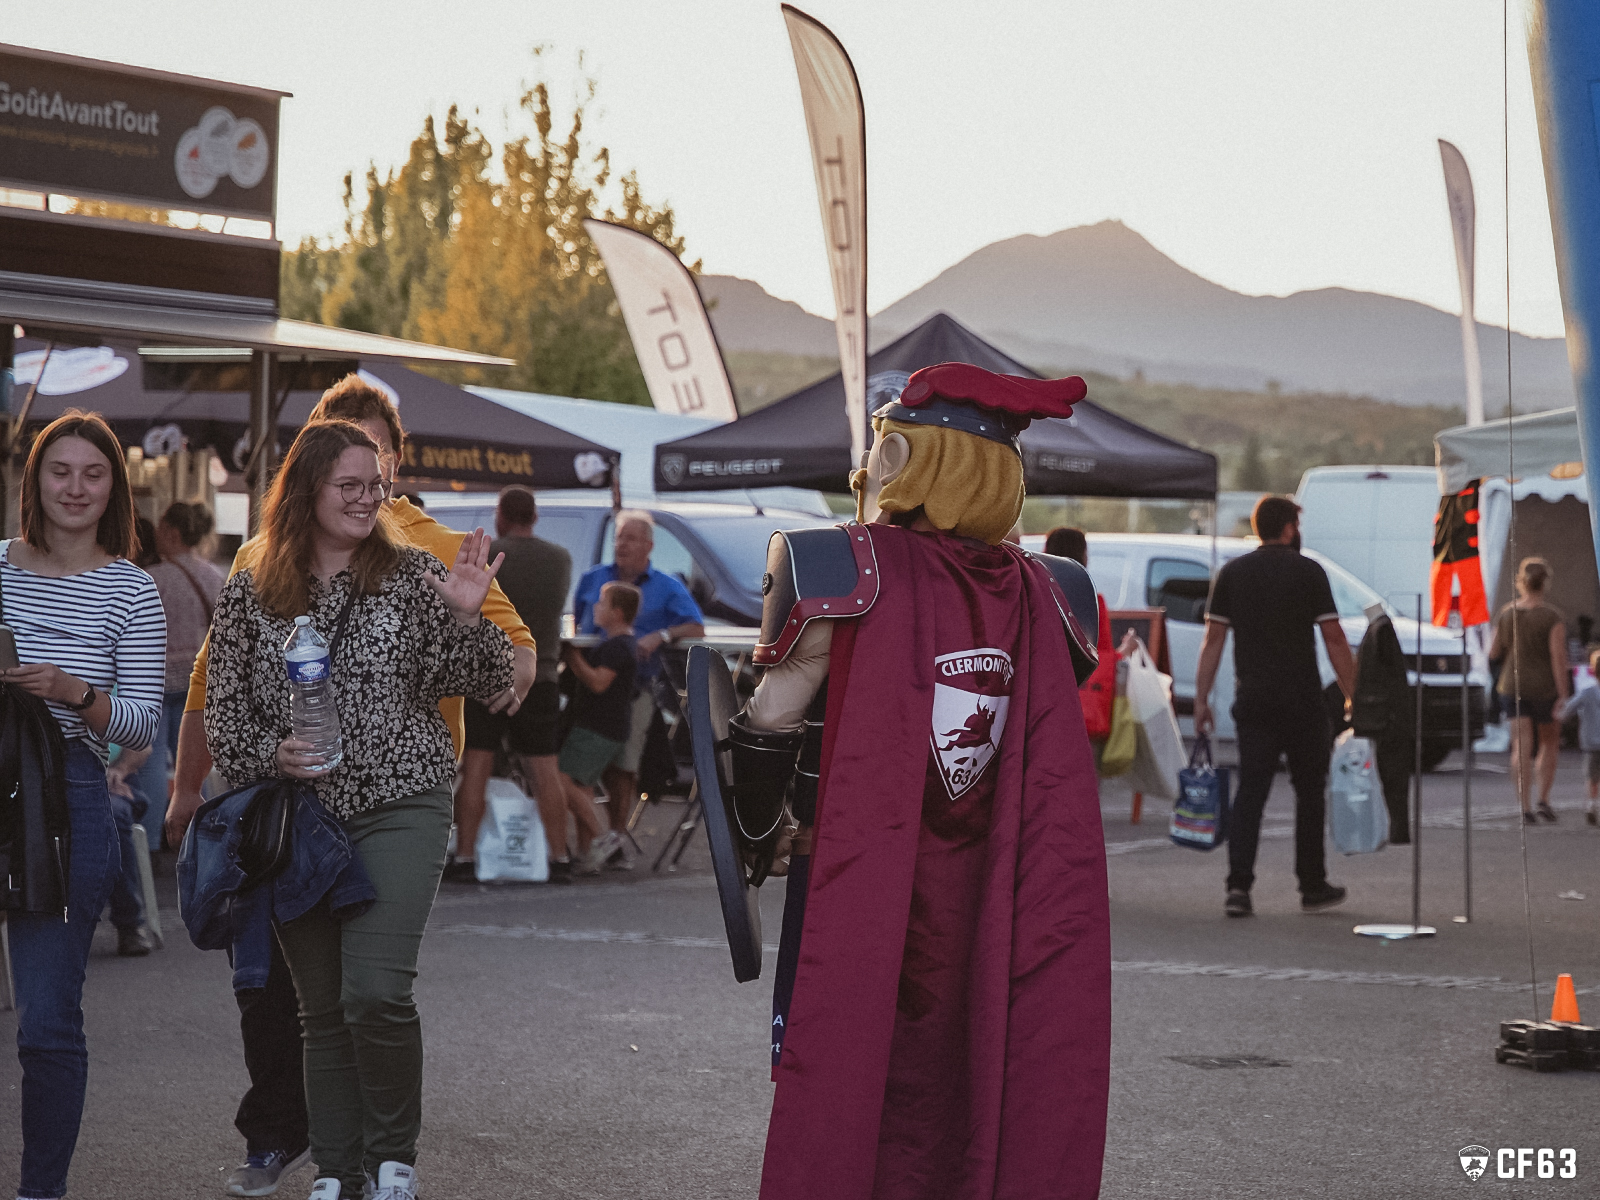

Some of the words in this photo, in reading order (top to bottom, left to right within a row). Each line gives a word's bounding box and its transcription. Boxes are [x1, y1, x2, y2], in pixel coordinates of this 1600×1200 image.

[421, 446, 483, 472] avant
[486, 449, 535, 477] tout
[689, 458, 784, 477] PEUGEOT
[942, 657, 1004, 676] CLERMONT
[952, 768, 971, 785] 63
